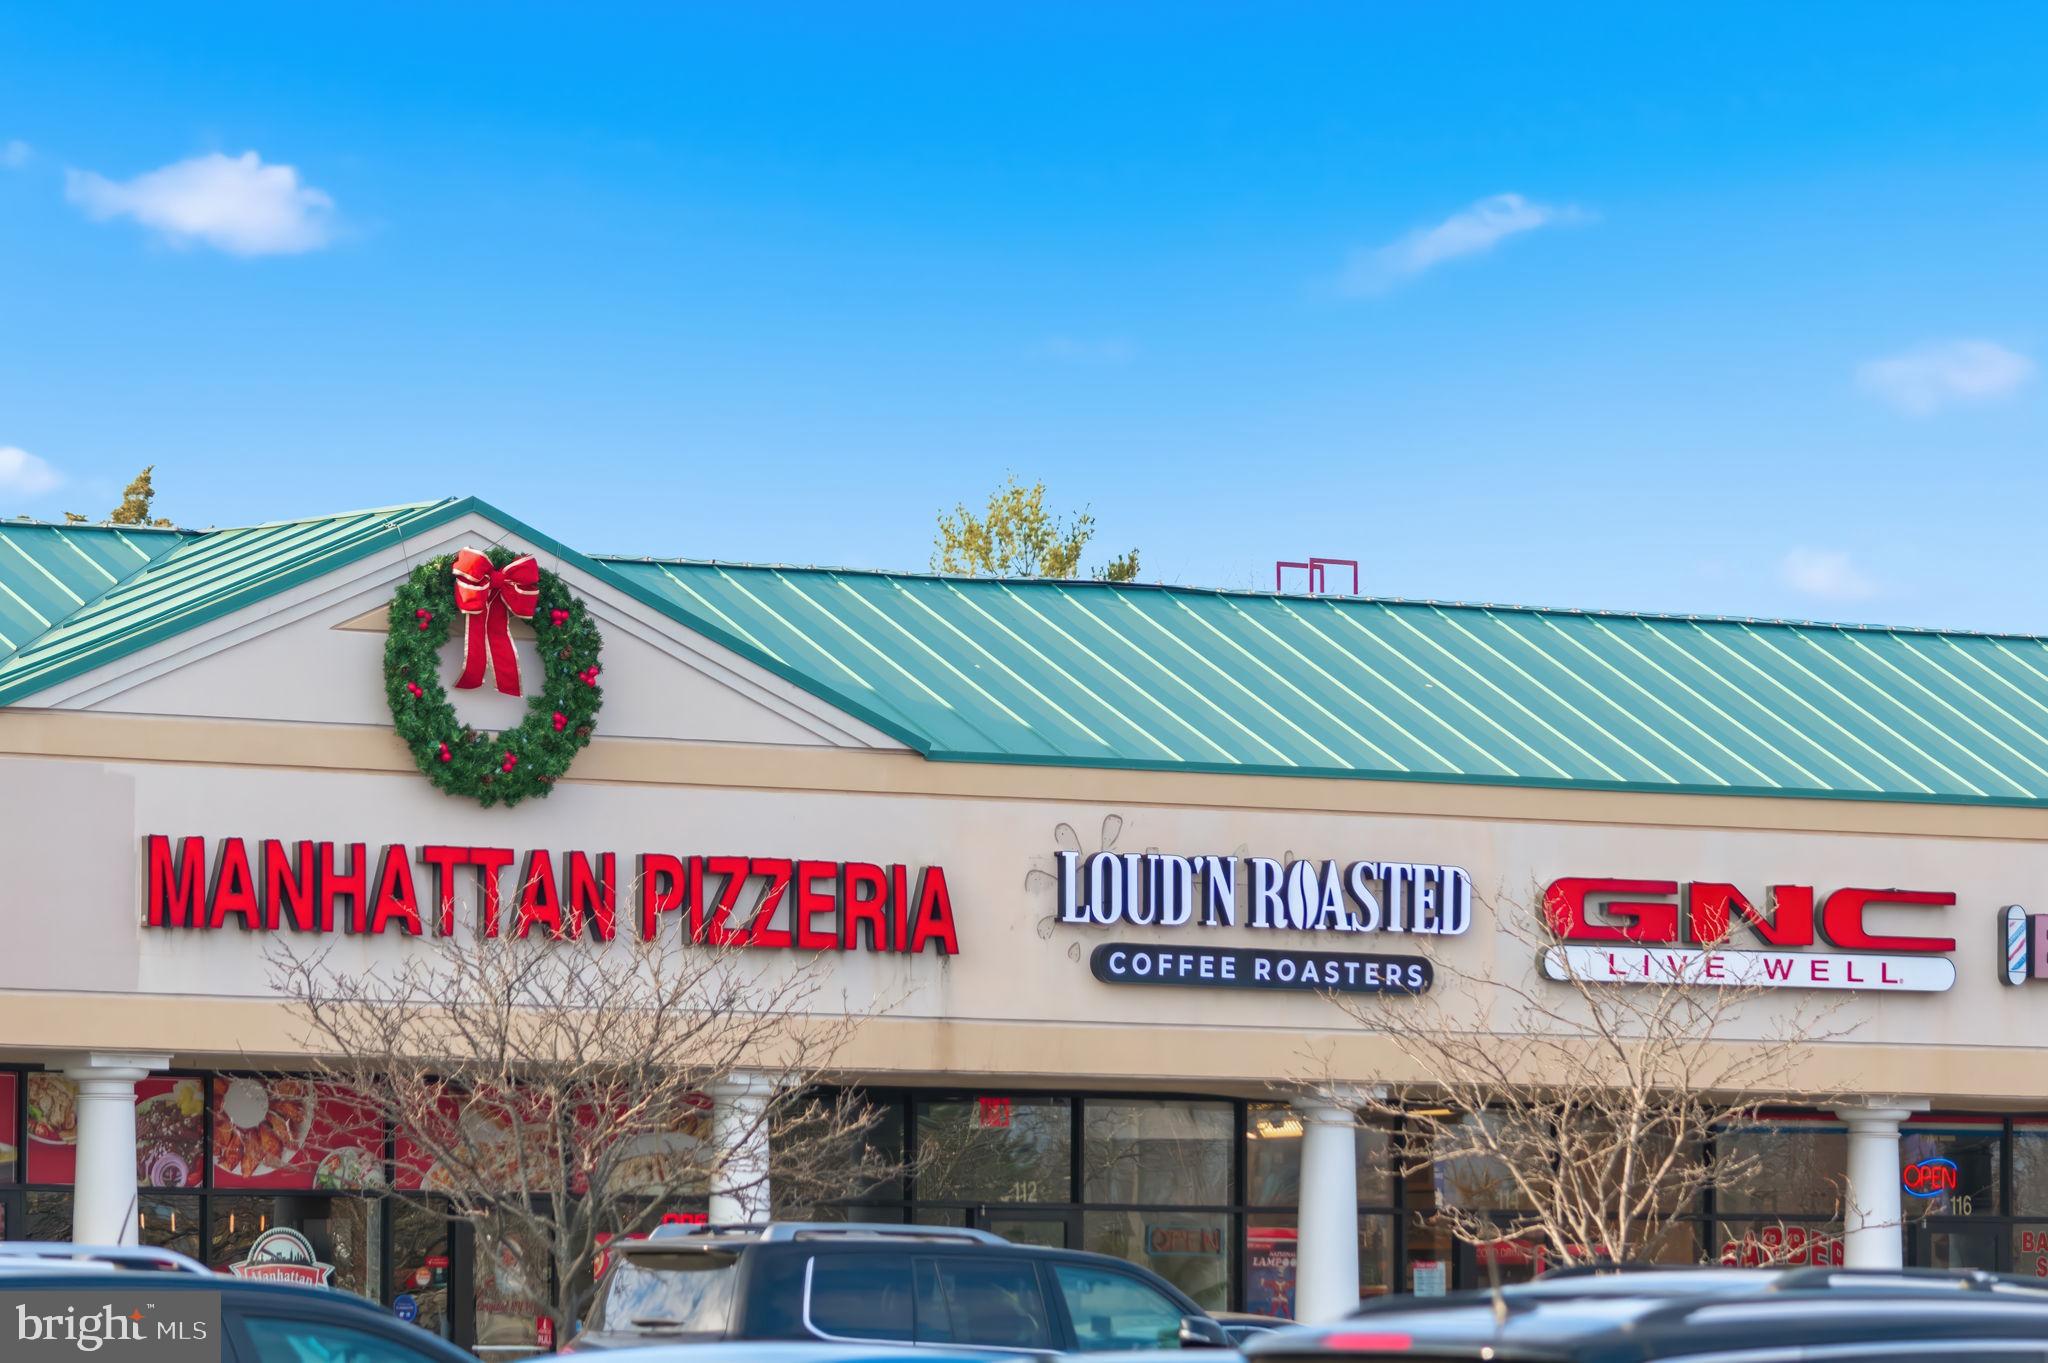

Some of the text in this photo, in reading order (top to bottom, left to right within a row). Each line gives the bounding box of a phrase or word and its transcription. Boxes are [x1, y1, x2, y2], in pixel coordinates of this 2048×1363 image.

[142, 834, 960, 956] MANHATTAN PIZZERIA
[1055, 850, 1473, 936] LOUD'N ROASTED
[1538, 876, 1957, 952] GNC
[1109, 951, 1424, 987] COFFEE ROASTERS
[1608, 952, 1900, 984] LIVE WELL
[1902, 1164, 1957, 1190] OPEN
[1950, 1195, 1972, 1216] 116
[1152, 1228, 1221, 1253] OPEN
[2021, 1231, 2048, 1253] BA
